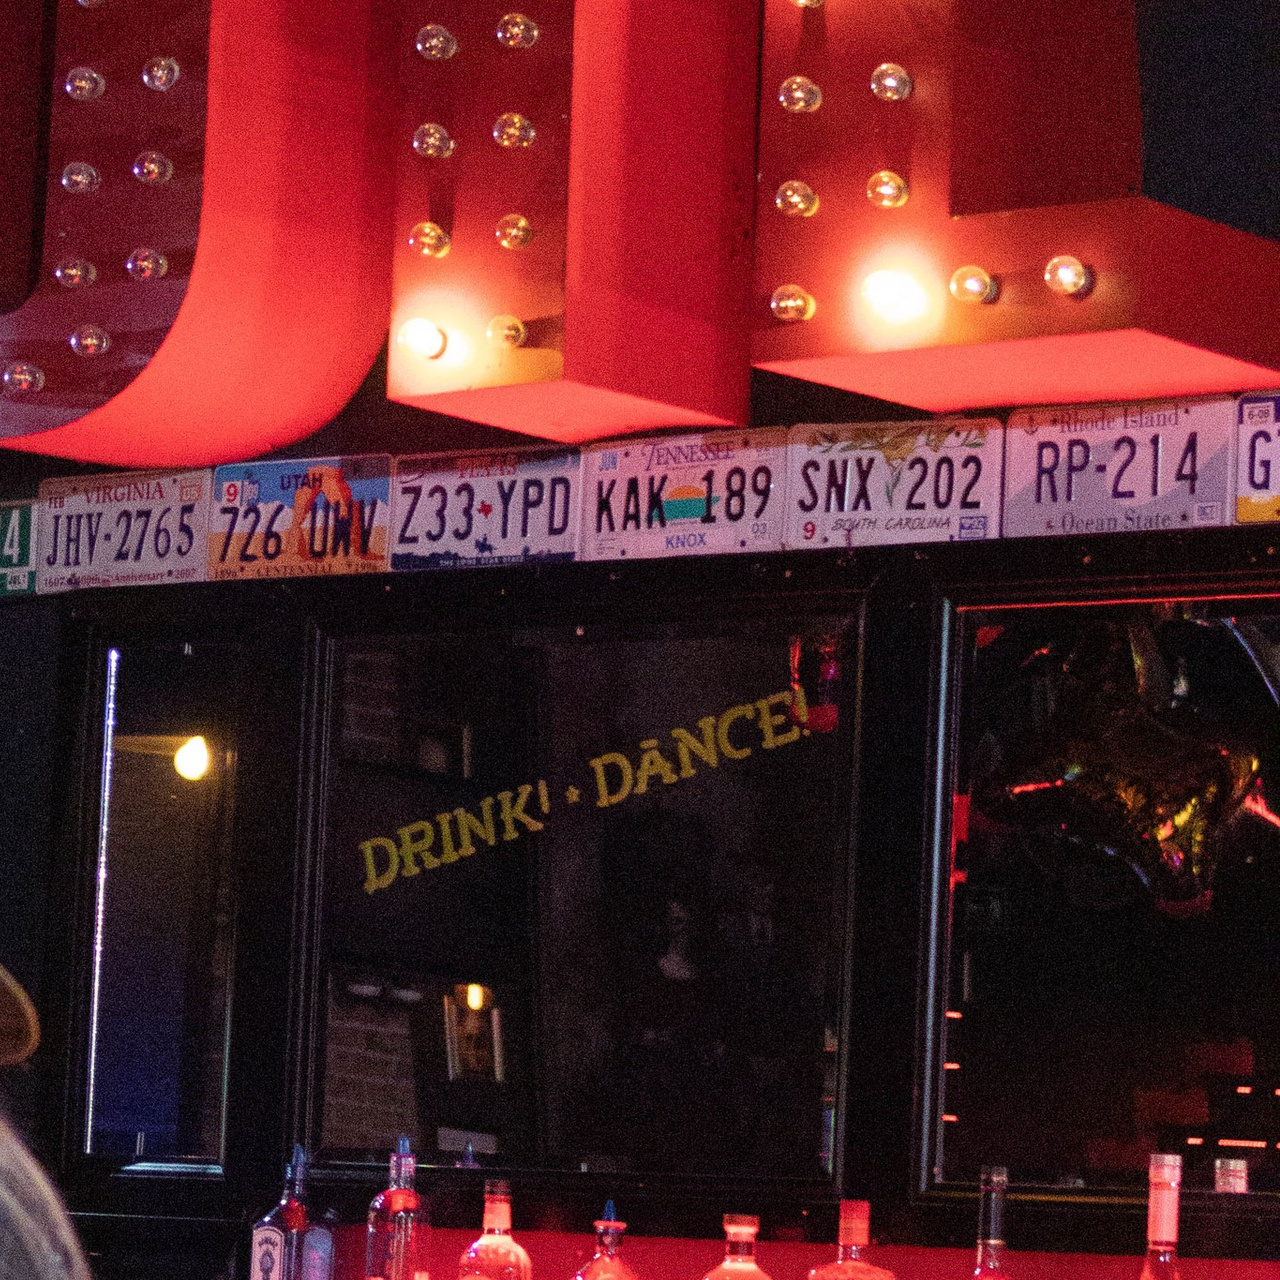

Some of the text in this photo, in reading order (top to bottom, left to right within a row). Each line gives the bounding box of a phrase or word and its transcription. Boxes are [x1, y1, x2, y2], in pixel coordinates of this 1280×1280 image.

[1060, 407, 1180, 433] Rhode Island
[641, 442, 735, 471] TENNESSEE
[1035, 431, 1198, 504] RP-214
[84, 481, 165, 504] VIRGINIA
[226, 484, 239, 503] 9
[280, 473, 323, 490] UTAH
[798, 455, 983, 513] SNX 202
[48, 497, 65, 509] FEB
[399, 477, 571, 544] Z33 YPD
[596, 465, 772, 533] KAK 189
[803, 521, 816, 540] 9
[831, 519, 877, 531] SOUTH
[885, 517, 950, 530] CAROLINA
[1061, 507, 1171, 531] Ocean State
[221, 505, 282, 563] 726
[665, 532, 707, 549] KNOX
[360, 686, 812, 896] DRINK! DANCE!
